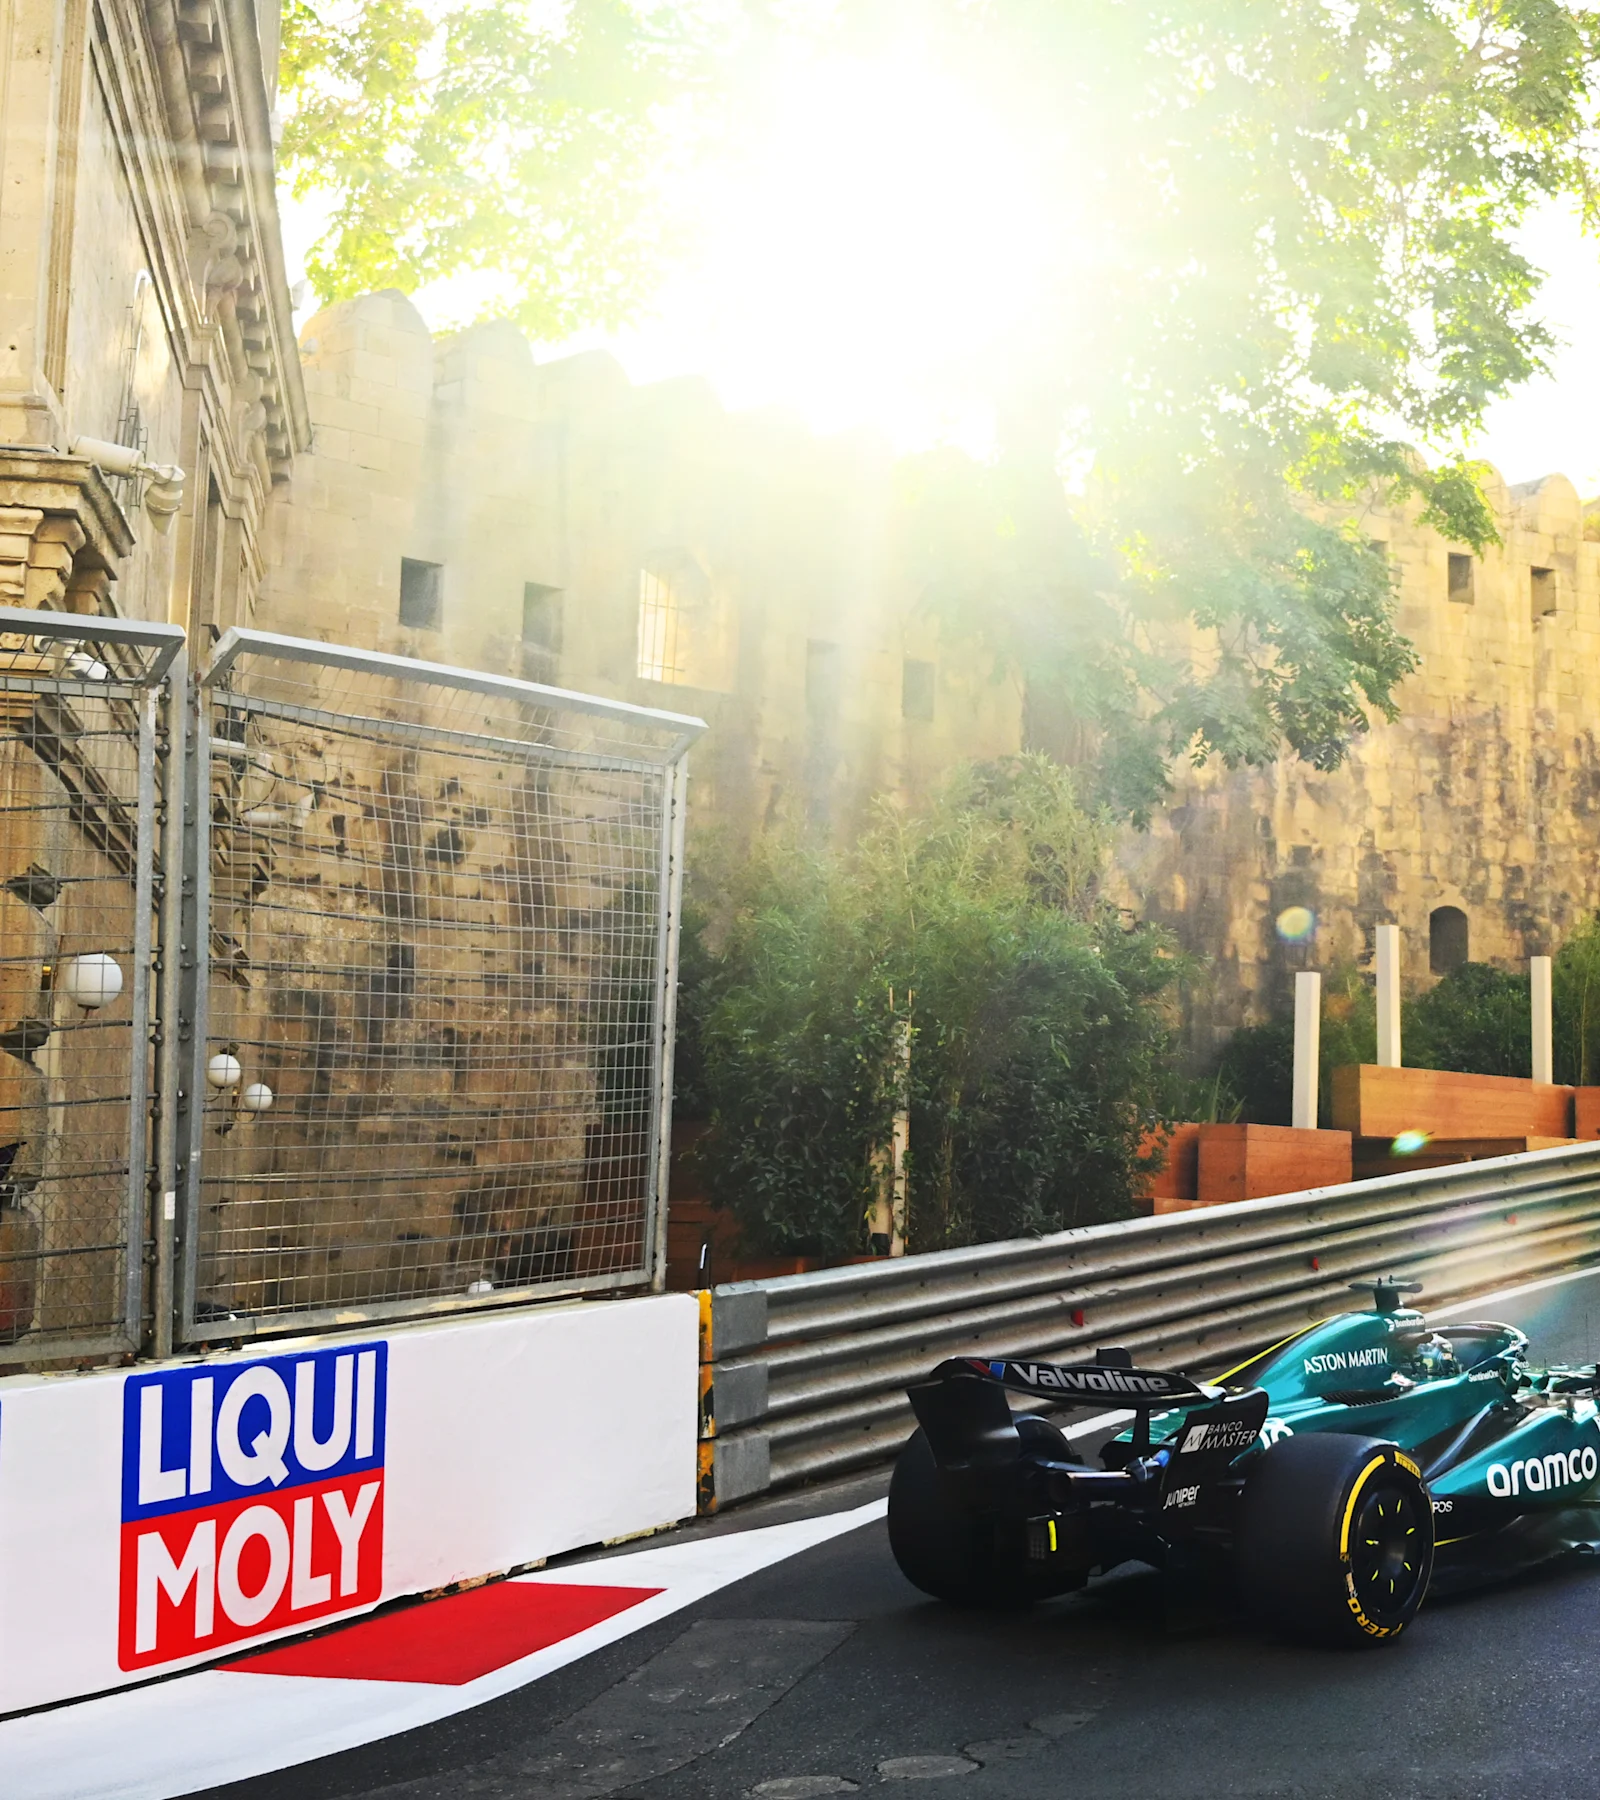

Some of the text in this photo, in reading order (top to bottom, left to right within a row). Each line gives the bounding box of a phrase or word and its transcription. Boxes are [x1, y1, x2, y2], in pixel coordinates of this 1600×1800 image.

[1011, 1362, 1171, 1392] Valvoline
[1303, 1347, 1388, 1375] ASTON MARTIN
[138, 1350, 376, 1505] LIQUI
[1200, 1429, 1257, 1451] MASTER
[1207, 1421, 1243, 1434] BANCO
[1486, 1446, 1597, 1498] aramco
[135, 1480, 381, 1655] MOLY
[1347, 1596, 1390, 1638] ZERO
